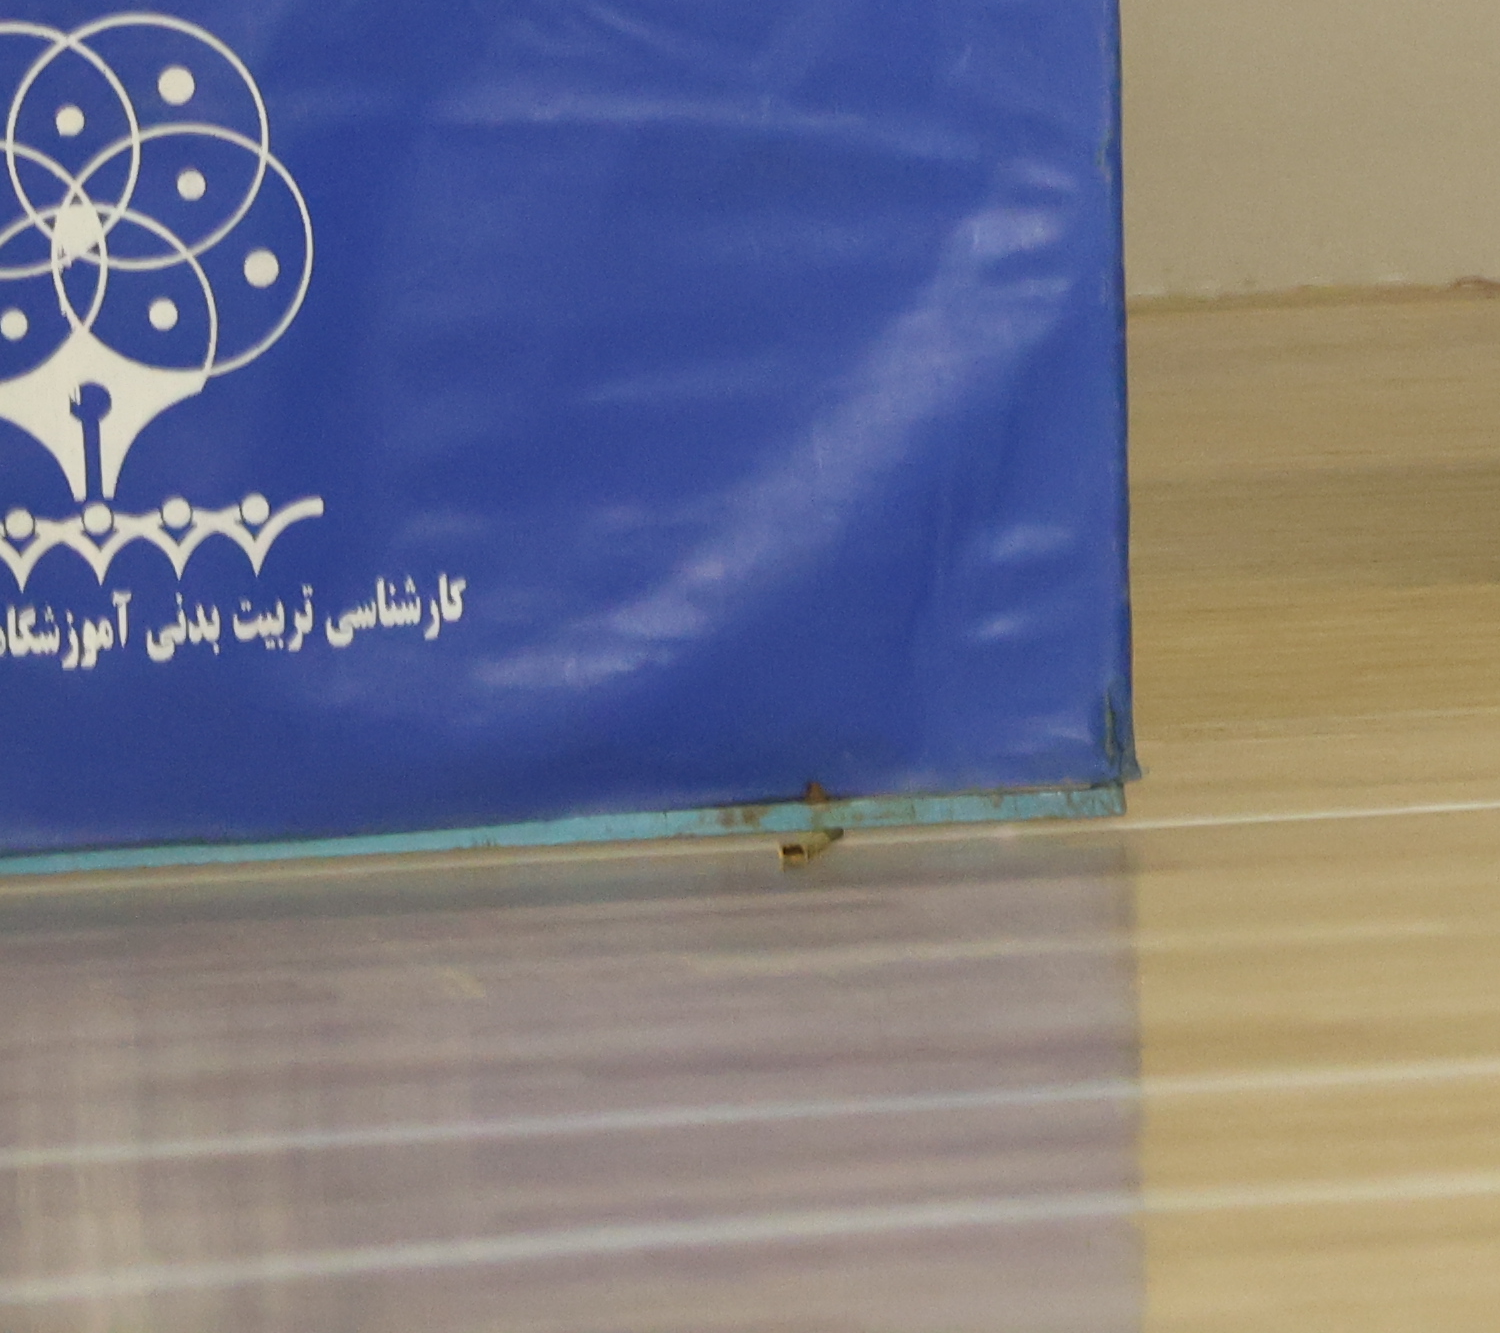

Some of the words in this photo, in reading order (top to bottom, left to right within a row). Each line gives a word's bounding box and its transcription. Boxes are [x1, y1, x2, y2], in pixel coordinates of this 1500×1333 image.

[145, 591, 221, 663] بدنی
[231, 584, 314, 652] تربیت
[325, 573, 468, 648] کارشناسی
